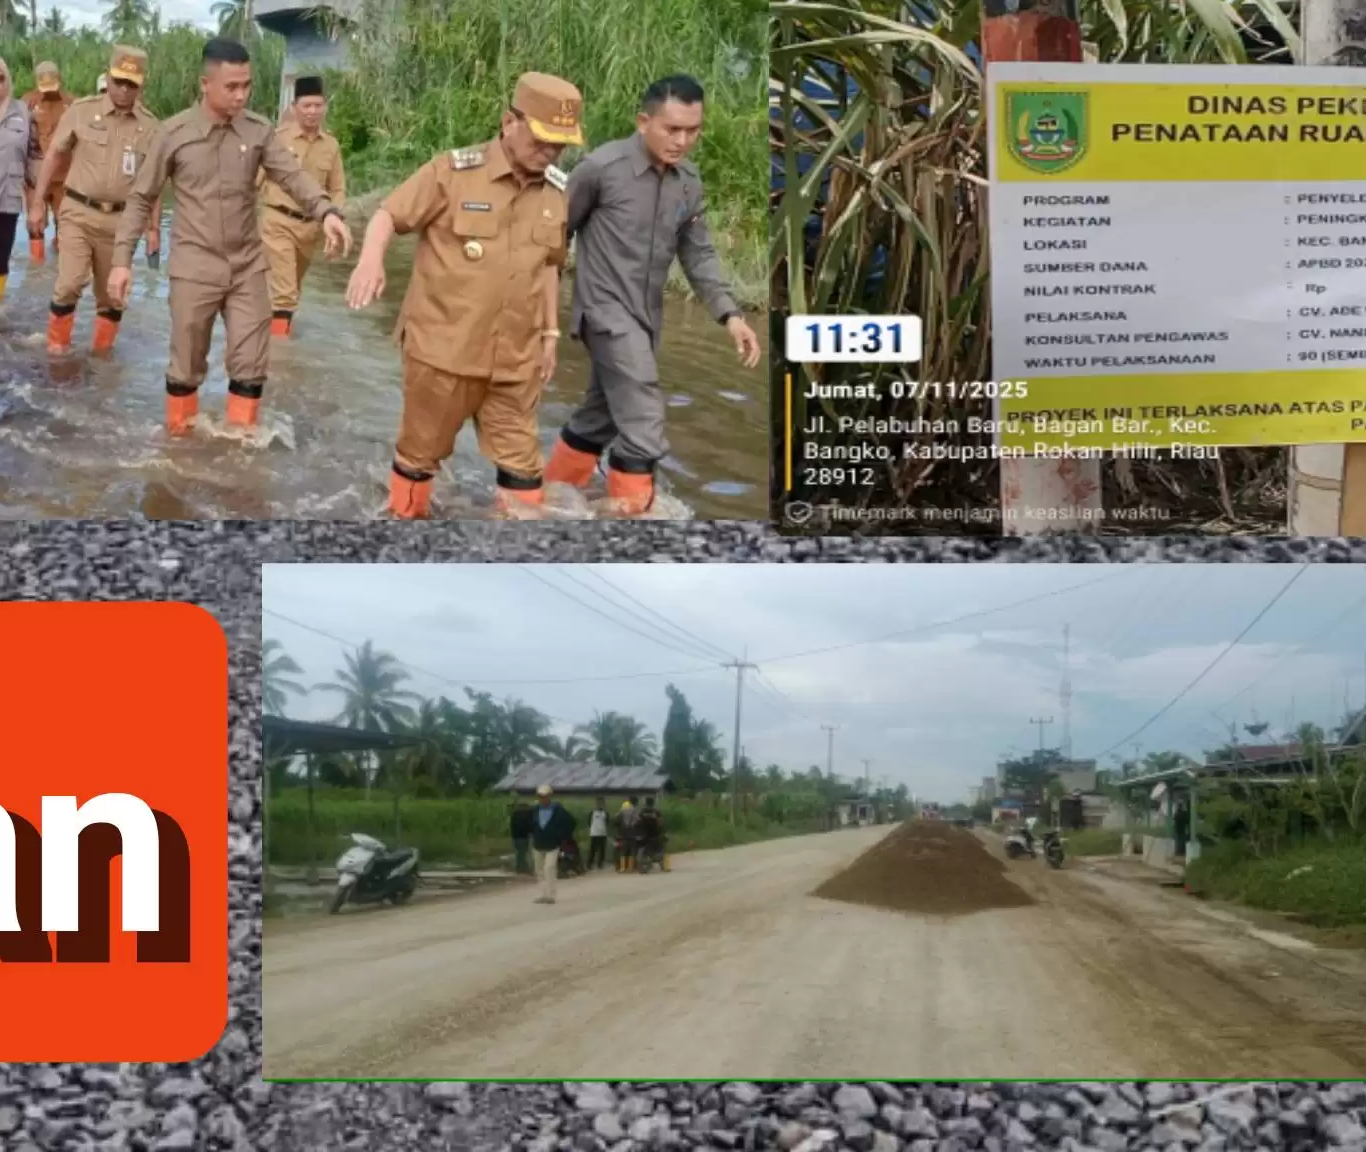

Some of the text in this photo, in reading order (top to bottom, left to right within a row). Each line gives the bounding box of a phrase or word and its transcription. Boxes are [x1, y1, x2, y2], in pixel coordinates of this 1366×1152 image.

[1187, 95, 1287, 115] DINAS
[1112, 123, 1288, 142] PENATAAN
[1023, 195, 1110, 206] PROGRAM
[1023, 216, 1111, 227] KEGIATAN
[1023, 239, 1087, 251] LOKASI
[1023, 262, 1095, 274] SUMBER
[1099, 261, 1148, 272] DANA
[1297, 259, 1342, 269] APBD
[1023, 285, 1069, 297] NILAI
[1073, 283, 1157, 295] KONTRAK
[1305, 283, 1327, 295] Rp
[1024, 310, 1128, 323] PELAKSANA
[1299, 307, 1325, 317] CV.
[1329, 306, 1363, 316] ADE
[1025, 332, 1130, 346] KONSULTAN
[1134, 331, 1229, 343] PENGAWAS
[1299, 329, 1325, 339] CV.
[1024, 356, 1087, 369] WAKTU
[1091, 353, 1216, 366] PELAKSANAAN
[1298, 351, 1317, 361] 90
[1007, 407, 1097, 423] PROYEK
[1104, 406, 1132, 419] INI
[1139, 403, 1282, 418] TERLAKSANA
[1289, 399, 1345, 414] ATAS
